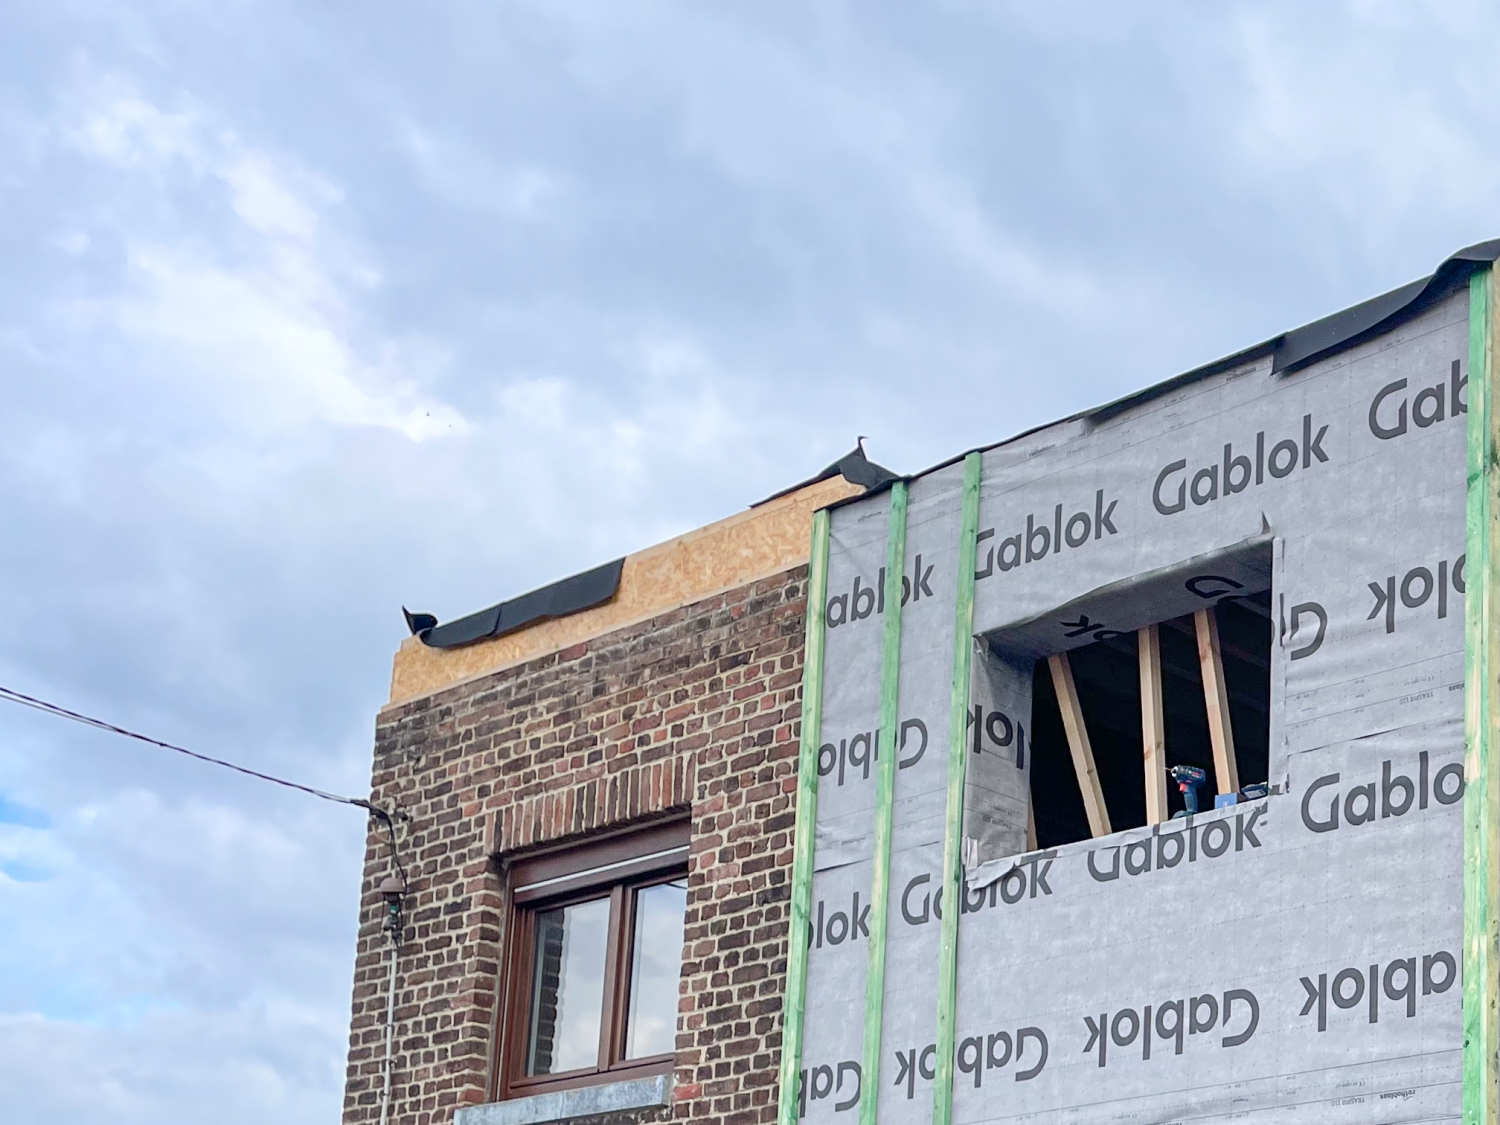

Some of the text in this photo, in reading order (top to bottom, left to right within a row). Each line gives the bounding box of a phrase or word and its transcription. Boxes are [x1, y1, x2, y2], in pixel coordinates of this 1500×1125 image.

[1152, 414, 1330, 516] Gablok
[1087, 803, 1262, 882] Gablok
[1301, 750, 1464, 833] Gablo
[1083, 989, 1260, 1068] Gablok
[1299, 951, 1464, 1032] ablok
[894, 1026, 1049, 1100] Gabok
